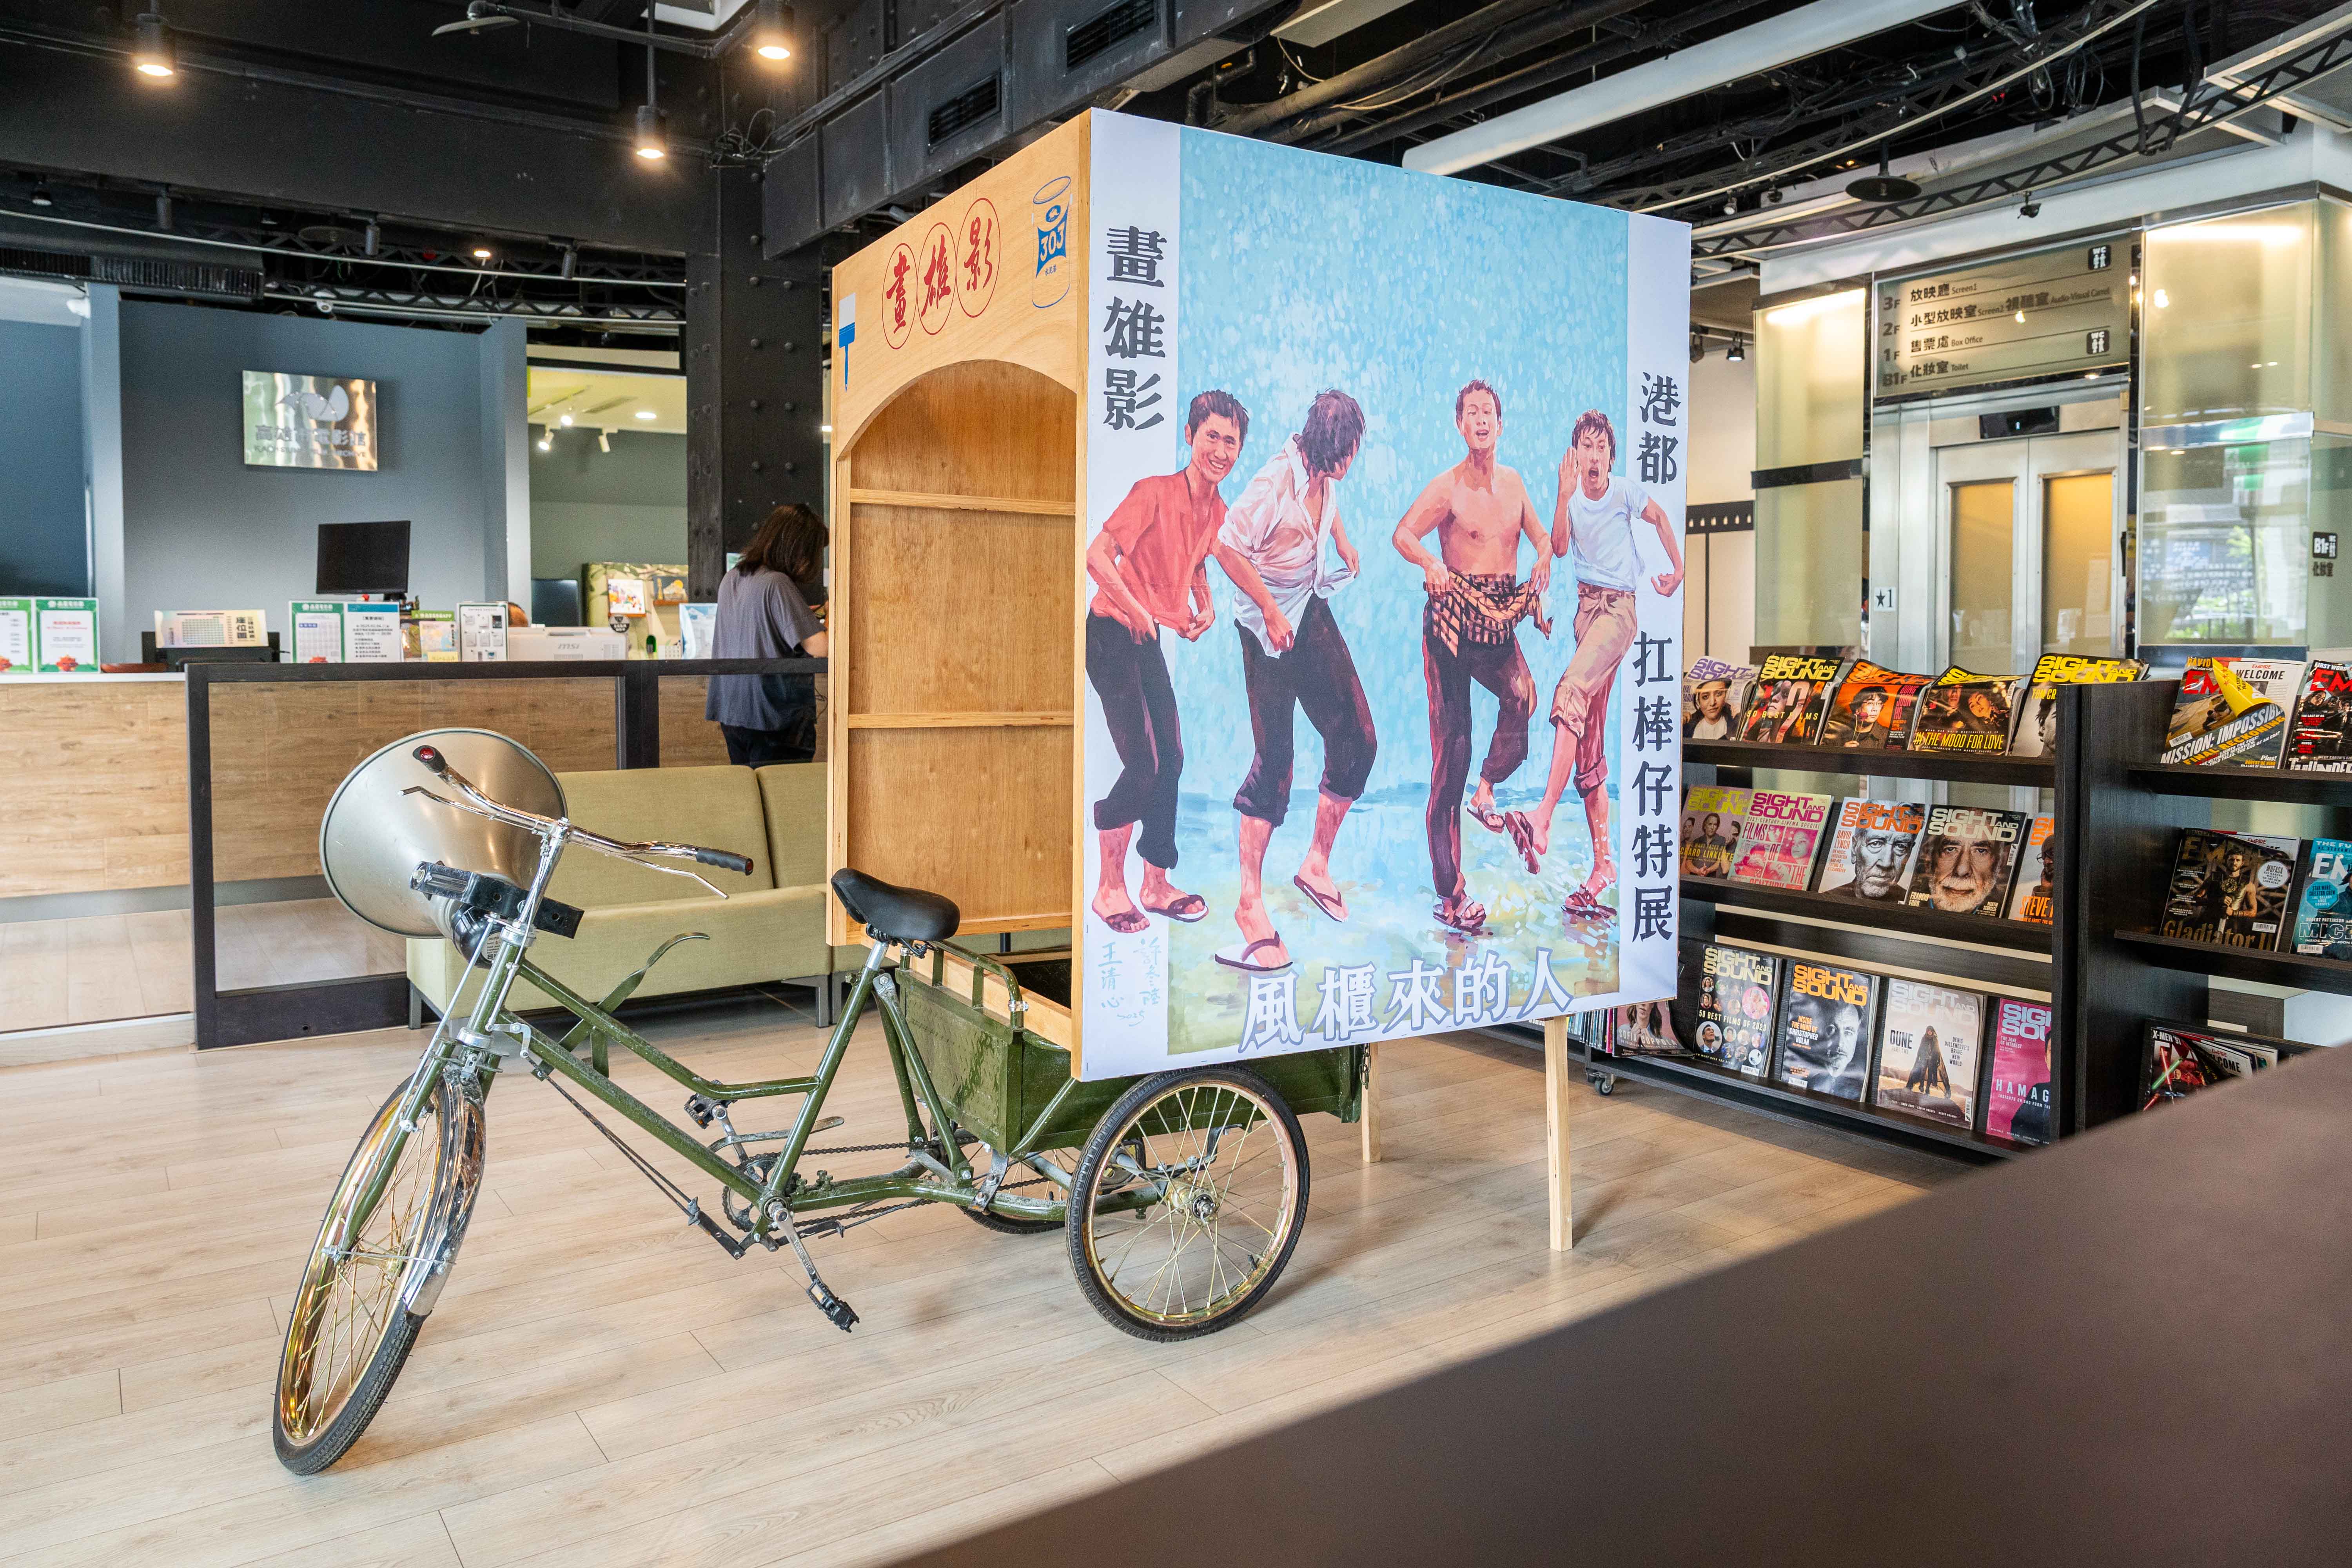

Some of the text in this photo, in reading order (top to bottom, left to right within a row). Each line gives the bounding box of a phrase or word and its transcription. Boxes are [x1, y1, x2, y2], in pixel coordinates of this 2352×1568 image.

[1040, 221, 1065, 261] 303
[2092, 246, 2107, 254] WC
[1910, 283, 1977, 301] 放映廳 Screen1
[1883, 297, 1900, 311] 3F
[1910, 305, 1976, 327] 小型放映室
[1103, 226, 1169, 430] 畫雄影
[1882, 322, 1900, 336] 2F
[2091, 331, 2105, 339] WC
[1911, 335, 1949, 352] 售票處
[1964, 336, 1983, 345] Office
[1884, 348, 1900, 361] 1F
[1951, 363, 1969, 371] Toilet
[1882, 373, 1908, 386] B1F
[1636, 372, 1681, 484] 港都
[1888, 589, 1893, 608] 1
[1694, 658, 1753, 675] SIGHT
[1764, 655, 1826, 669] SIGHT
[2038, 655, 2120, 673] SIGHT
[2187, 657, 2211, 667] DAVID
[1760, 667, 1835, 680] SOUND
[2033, 669, 2135, 683] SOUND
[2236, 669, 2285, 680] WELCOME
[2032, 688, 2046, 700] TOM
[1913, 731, 2004, 750] IN THE MOOD FOR LOVE
[2160, 732, 2215, 764] MISSION:
[2183, 748, 2220, 765] FINAL
[2218, 716, 2285, 749] RECKONING
[1632, 630, 1674, 943] 扛棒仔特展
[1691, 787, 1744, 803] SIGHT
[1753, 792, 1813, 809] SIGHT
[1749, 804, 1824, 823] SOUND
[1844, 802, 1911, 820] SIGHT
[1930, 808, 2003, 827] SIGHT
[1994, 821, 2019, 829] AND
[1742, 822, 1768, 840] FILMS
[1840, 815, 1922, 834] SOUND
[1928, 822, 2016, 842] SOUND
[1837, 830, 1852, 839] DAVID
[1768, 843, 1780, 861] OF
[1834, 839, 1851, 849] LYNCH
[1790, 865, 1807, 884] THE
[2266, 864, 2283, 874] MUFASA
[1910, 891, 1929, 901] FRANCIS
[2019, 896, 2051, 917] STEVE
[2163, 920, 2273, 951] Gladiator II
[1704, 947, 1760, 970] SIGHT
[1703, 960, 1772, 985] SOUND
[1794, 964, 1868, 992] SIGHT AND
[1238, 946, 1574, 1054] 風櫃來的人
[1793, 979, 1867, 1006] SOUND
[1892, 982, 1975, 1012] SIGHT AND
[1891, 996, 1975, 1025] SOUND
[1708, 1011, 1722, 1022] BEST
[1723, 1015, 1741, 1026] FILMS
[1743, 1019, 1751, 1027] OF
[1752, 1022, 1767, 1032] 2023
[1798, 1016, 1813, 1025] INSIDE
[1800, 1023, 1811, 1032] MIND
[1619, 1029, 1678, 1046] SOFIA COPPOLA
[1789, 1027, 1818, 1041] CHRISTOPHER
[1795, 1036, 1809, 1045] NOLAN
[1890, 1029, 1913, 1049] DUNE
[2152, 1030, 2173, 1043] X-MEN
[1945, 1041, 1970, 1051] VILLENEUVE'S
[1996, 1078, 2049, 1103] HAMAG
